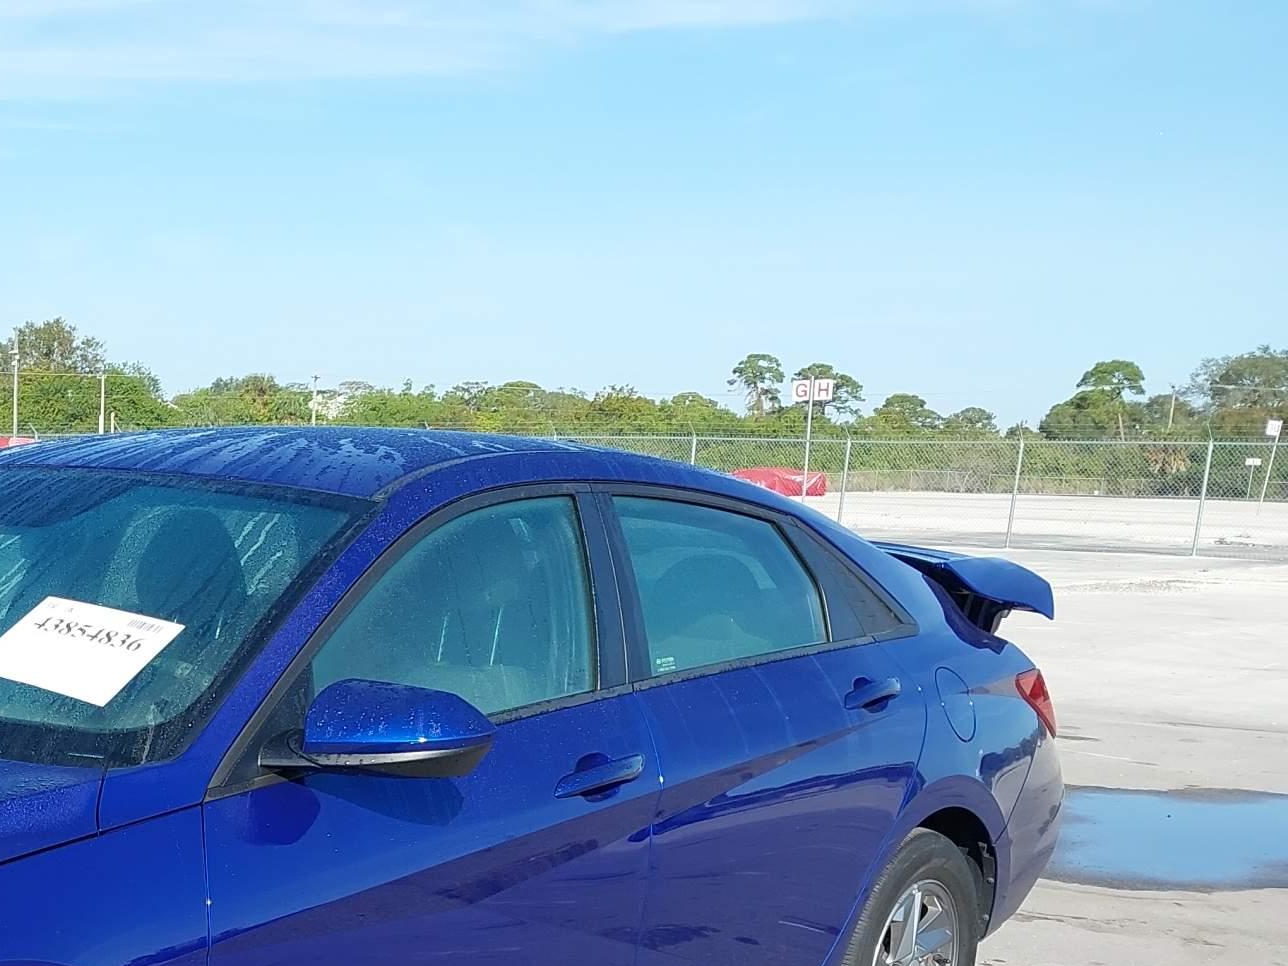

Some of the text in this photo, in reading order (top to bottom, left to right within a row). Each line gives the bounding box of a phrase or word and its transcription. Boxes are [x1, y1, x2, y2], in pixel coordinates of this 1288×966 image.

[795, 383, 808, 398] G
[817, 382, 830, 398] H
[34, 616, 145, 652] 43854836
